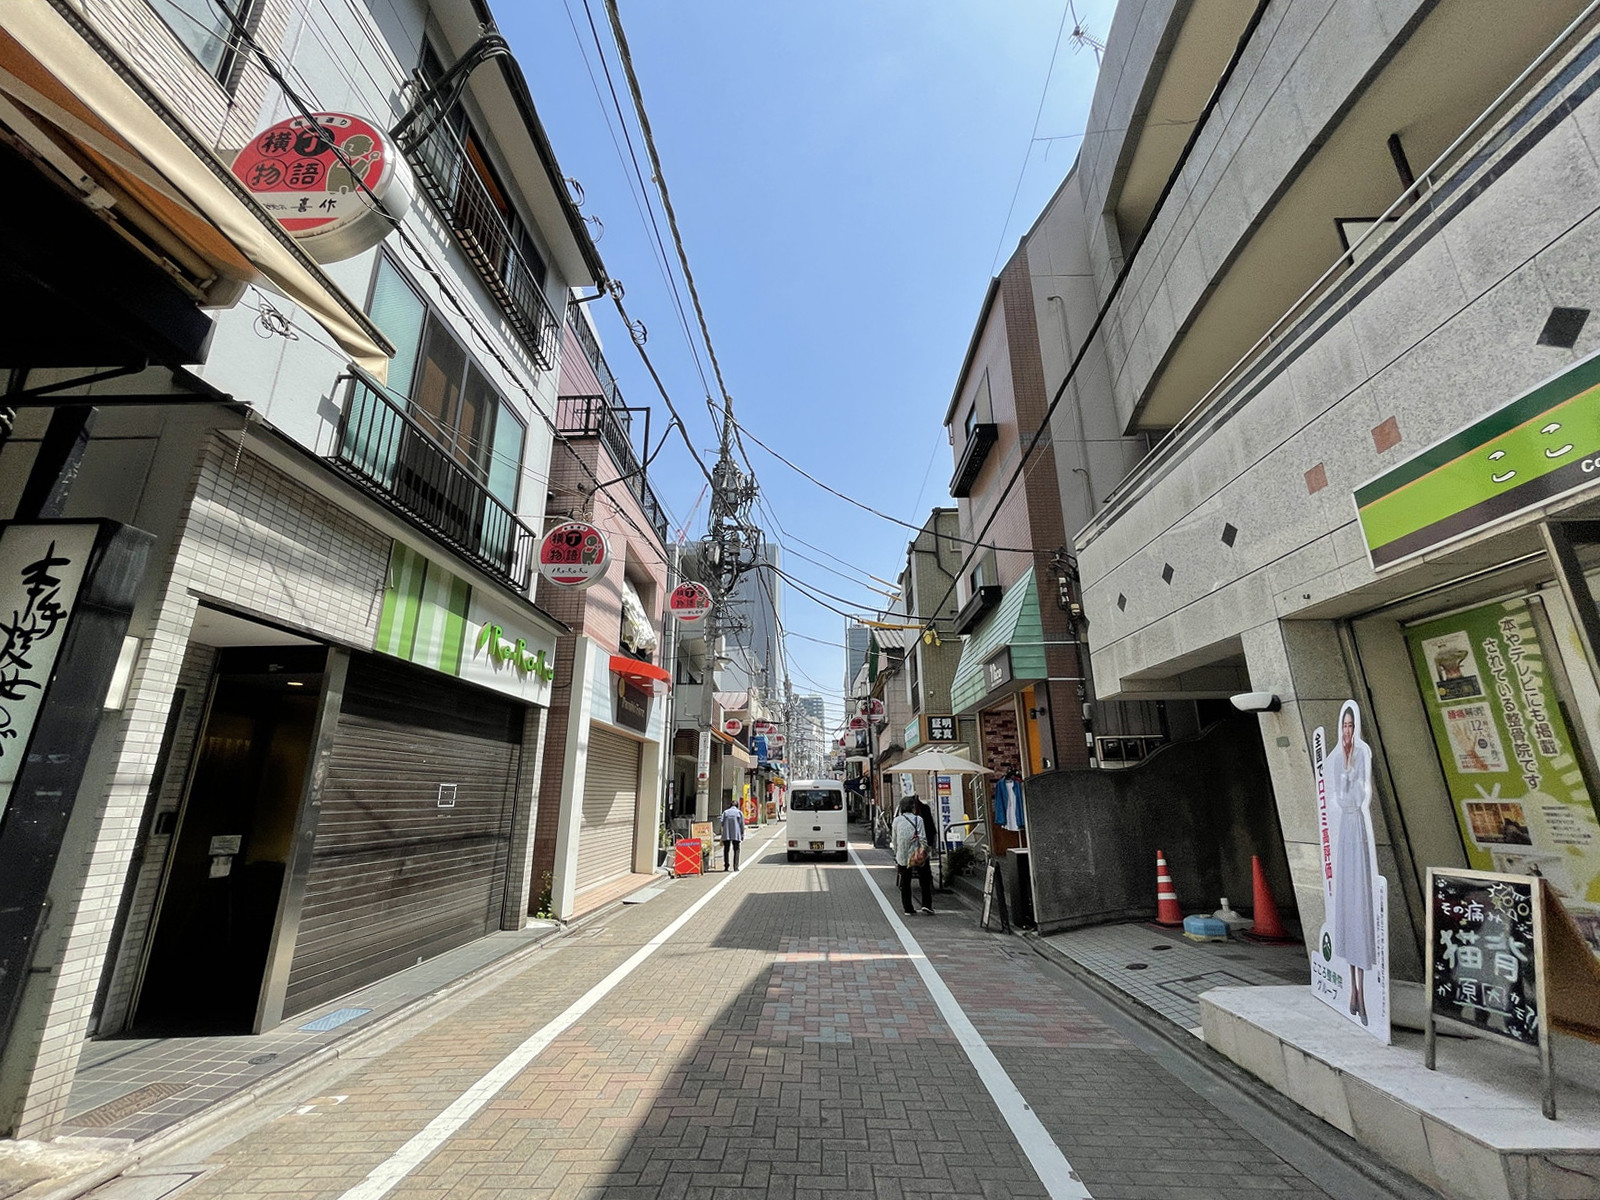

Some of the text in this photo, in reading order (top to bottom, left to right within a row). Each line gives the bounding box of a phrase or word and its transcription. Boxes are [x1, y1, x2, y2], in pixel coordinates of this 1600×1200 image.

[262, 128, 333, 153] 横丁
[252, 162, 319, 188] 物語
[553, 532, 580, 546] 横丁
[550, 549, 578, 561] 物語
[1501, 618, 1558, 755] 本やテレビにも掲載
[931, 718, 952, 728] 証明
[1484, 639, 1540, 790] されている整骨院です
[932, 729, 953, 739] 写真
[1441, 900, 1503, 924] その痛み
[1440, 929, 1529, 982] 猫背
